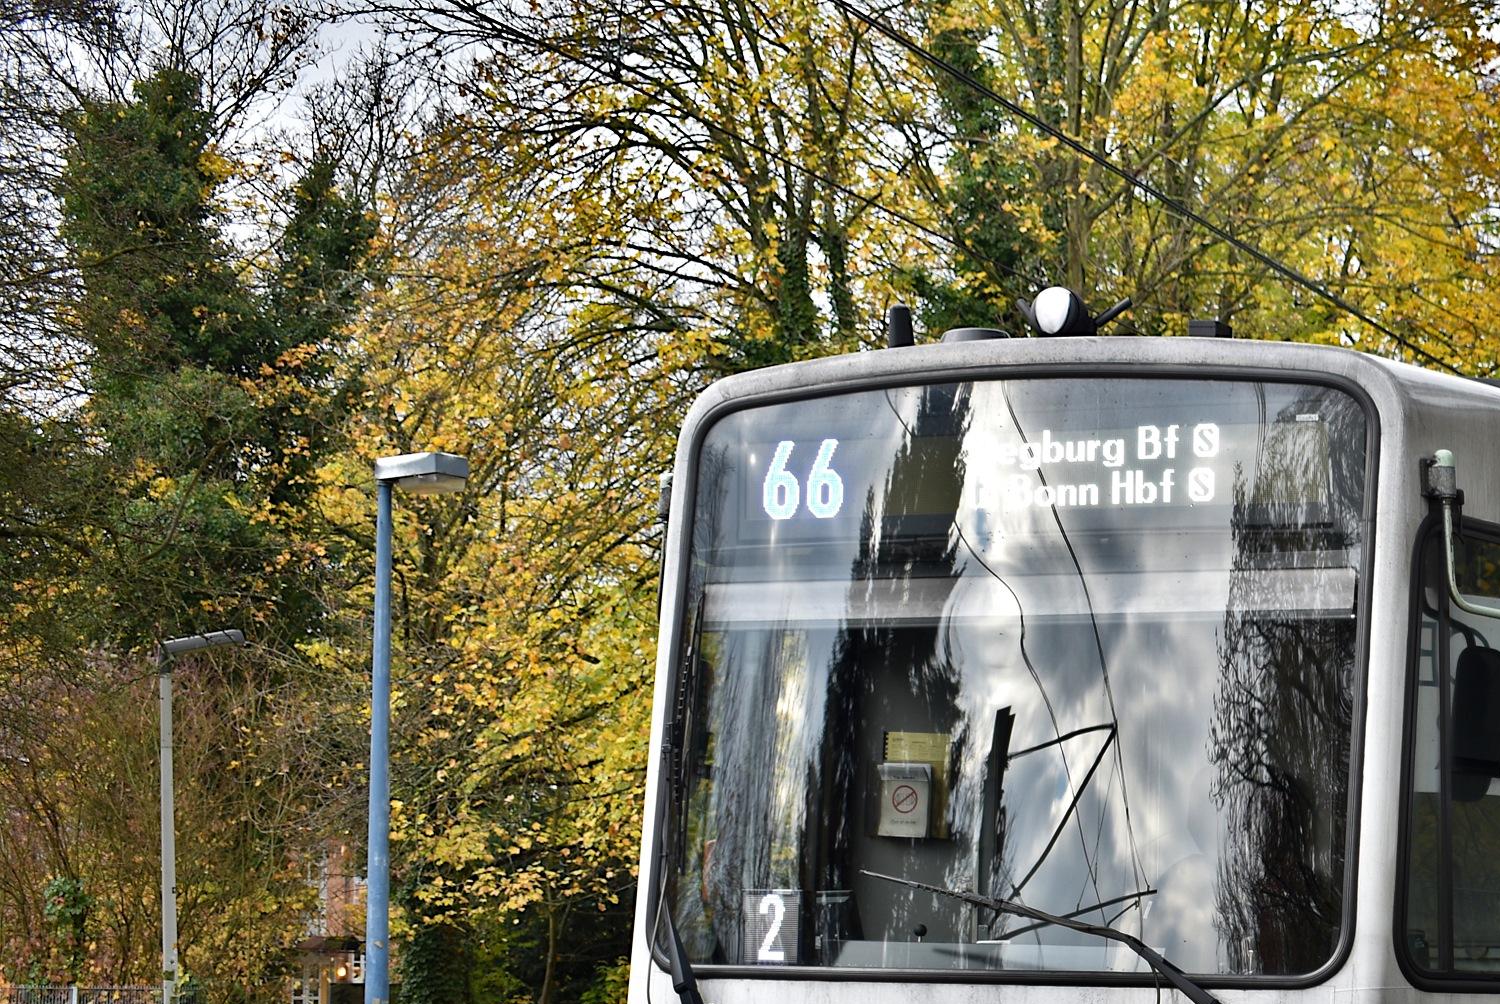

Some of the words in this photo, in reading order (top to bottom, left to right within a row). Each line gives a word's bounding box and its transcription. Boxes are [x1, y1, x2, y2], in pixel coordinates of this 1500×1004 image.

[970, 429, 1126, 472] egburg
[1137, 424, 1180, 460] Bf
[762, 437, 844, 521] 66
[1008, 474, 1100, 508] Bonn
[1111, 469, 1175, 504] Hbf
[757, 890, 786, 962] 2
